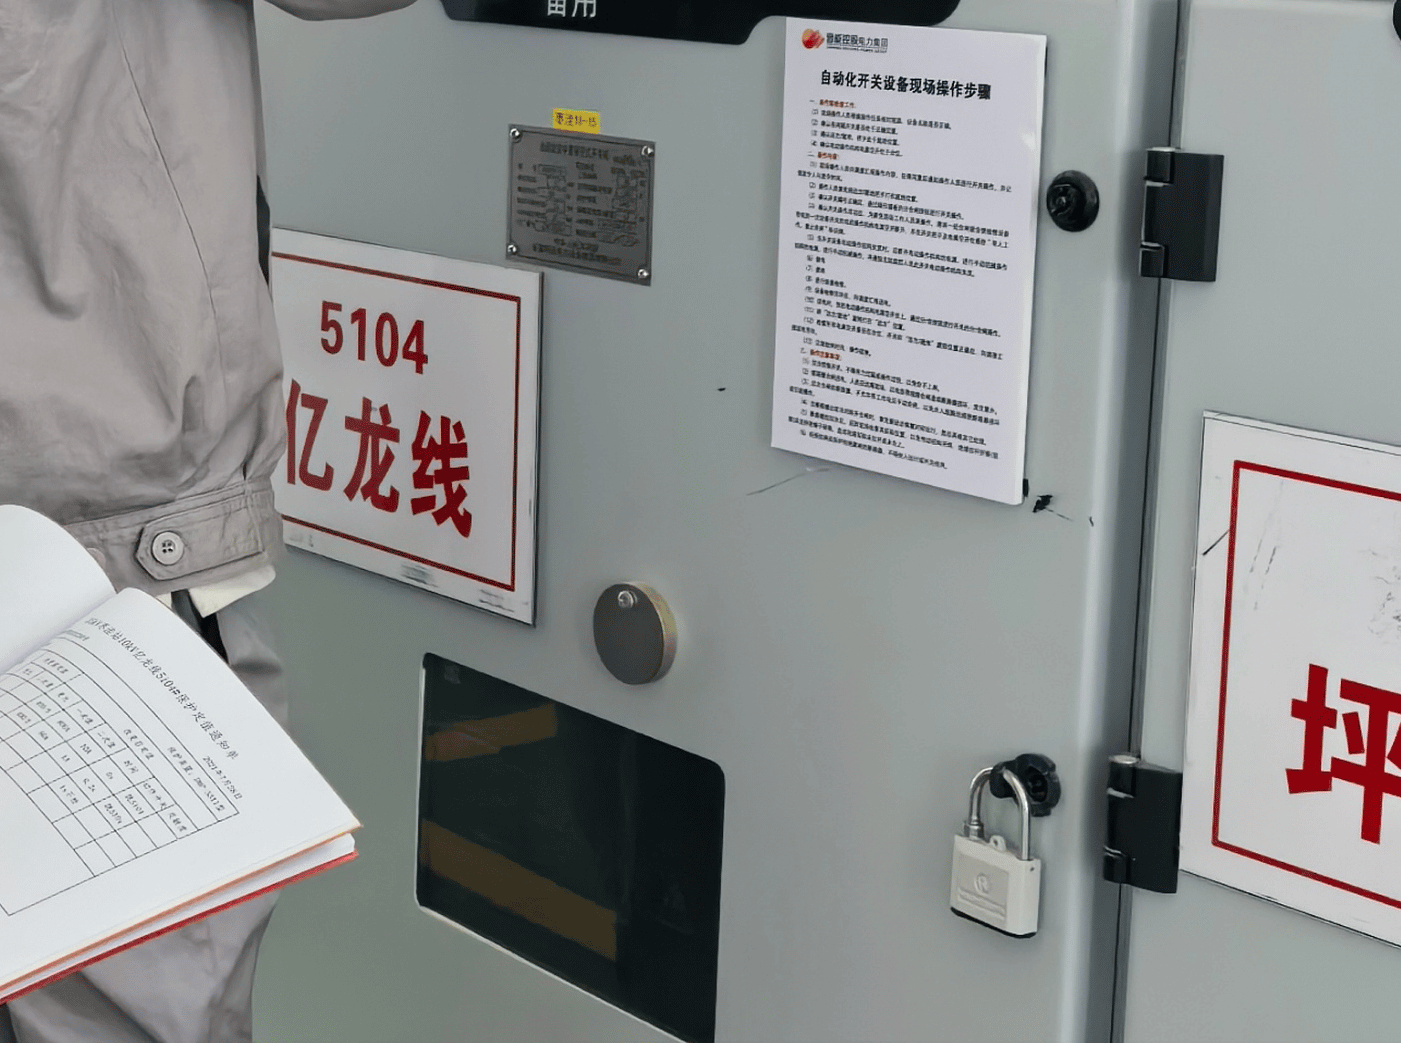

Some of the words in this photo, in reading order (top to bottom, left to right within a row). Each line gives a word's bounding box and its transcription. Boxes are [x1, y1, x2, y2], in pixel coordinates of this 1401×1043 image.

[820, 68, 992, 101] 自动化开关设备现场操作步骤
[320, 300, 429, 375] 5104
[285, 378, 473, 539] 亿龙线
[1285, 663, 1401, 845] 坪
